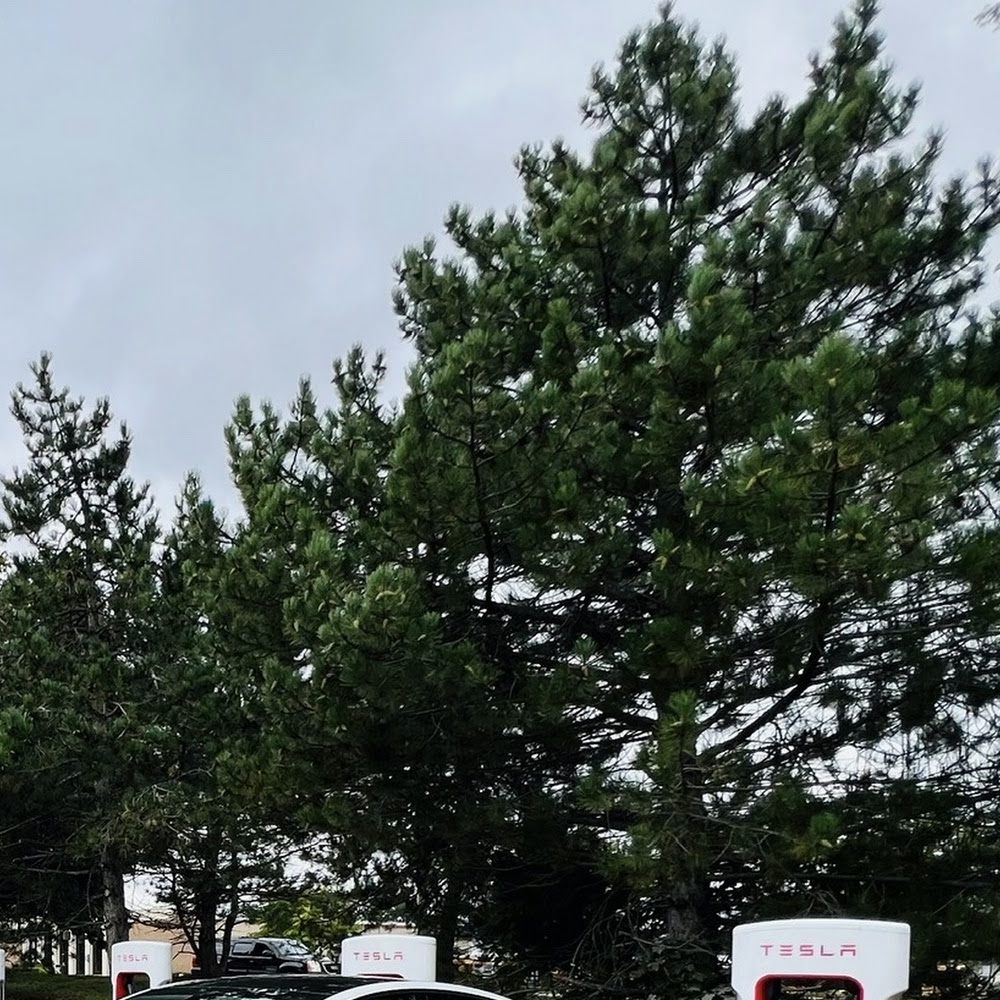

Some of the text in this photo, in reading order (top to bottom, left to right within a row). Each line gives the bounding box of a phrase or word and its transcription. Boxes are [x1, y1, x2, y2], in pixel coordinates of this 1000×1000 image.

[760, 944, 856, 957] TESLA
[117, 954, 148, 962] TESLA
[353, 951, 403, 961] TESLA
